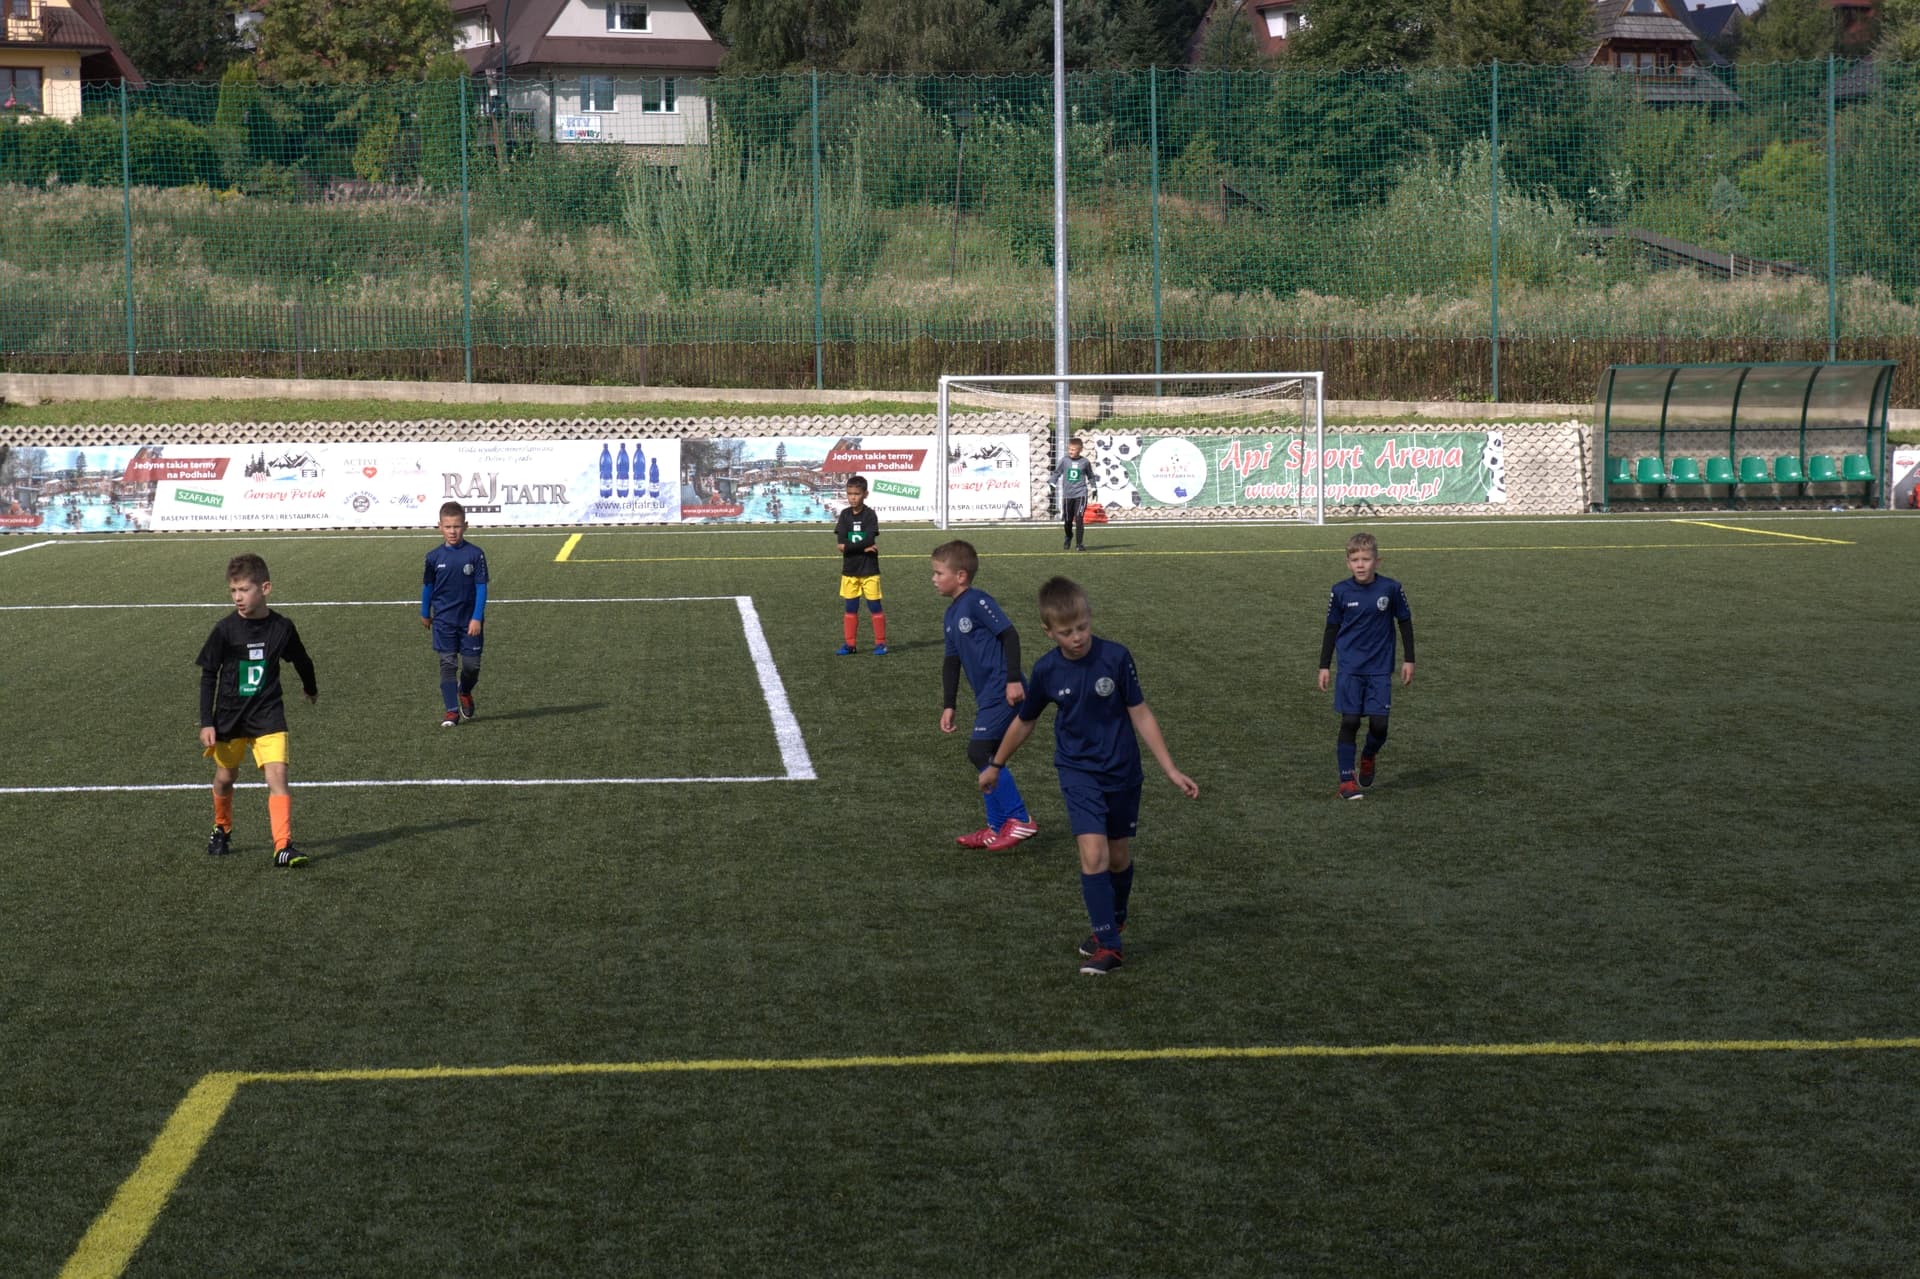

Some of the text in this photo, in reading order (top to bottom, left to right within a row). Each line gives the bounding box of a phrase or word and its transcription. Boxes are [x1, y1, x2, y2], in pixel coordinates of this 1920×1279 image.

[833, 452, 913, 461] Jedyne takie termy
[1219, 438, 1463, 477] Api Sport Arena
[133, 461, 216, 470] Jedyne takie termy
[878, 462, 913, 470] Podhalu
[180, 471, 217, 479] Podhalu
[1070, 470, 1078, 479] D
[442, 472, 499, 504] RAJ
[501, 484, 570, 504] TATR
[876, 482, 919, 496] SZAFLARY
[178, 491, 222, 505] SZAFLARY
[248, 666, 264, 686] D
